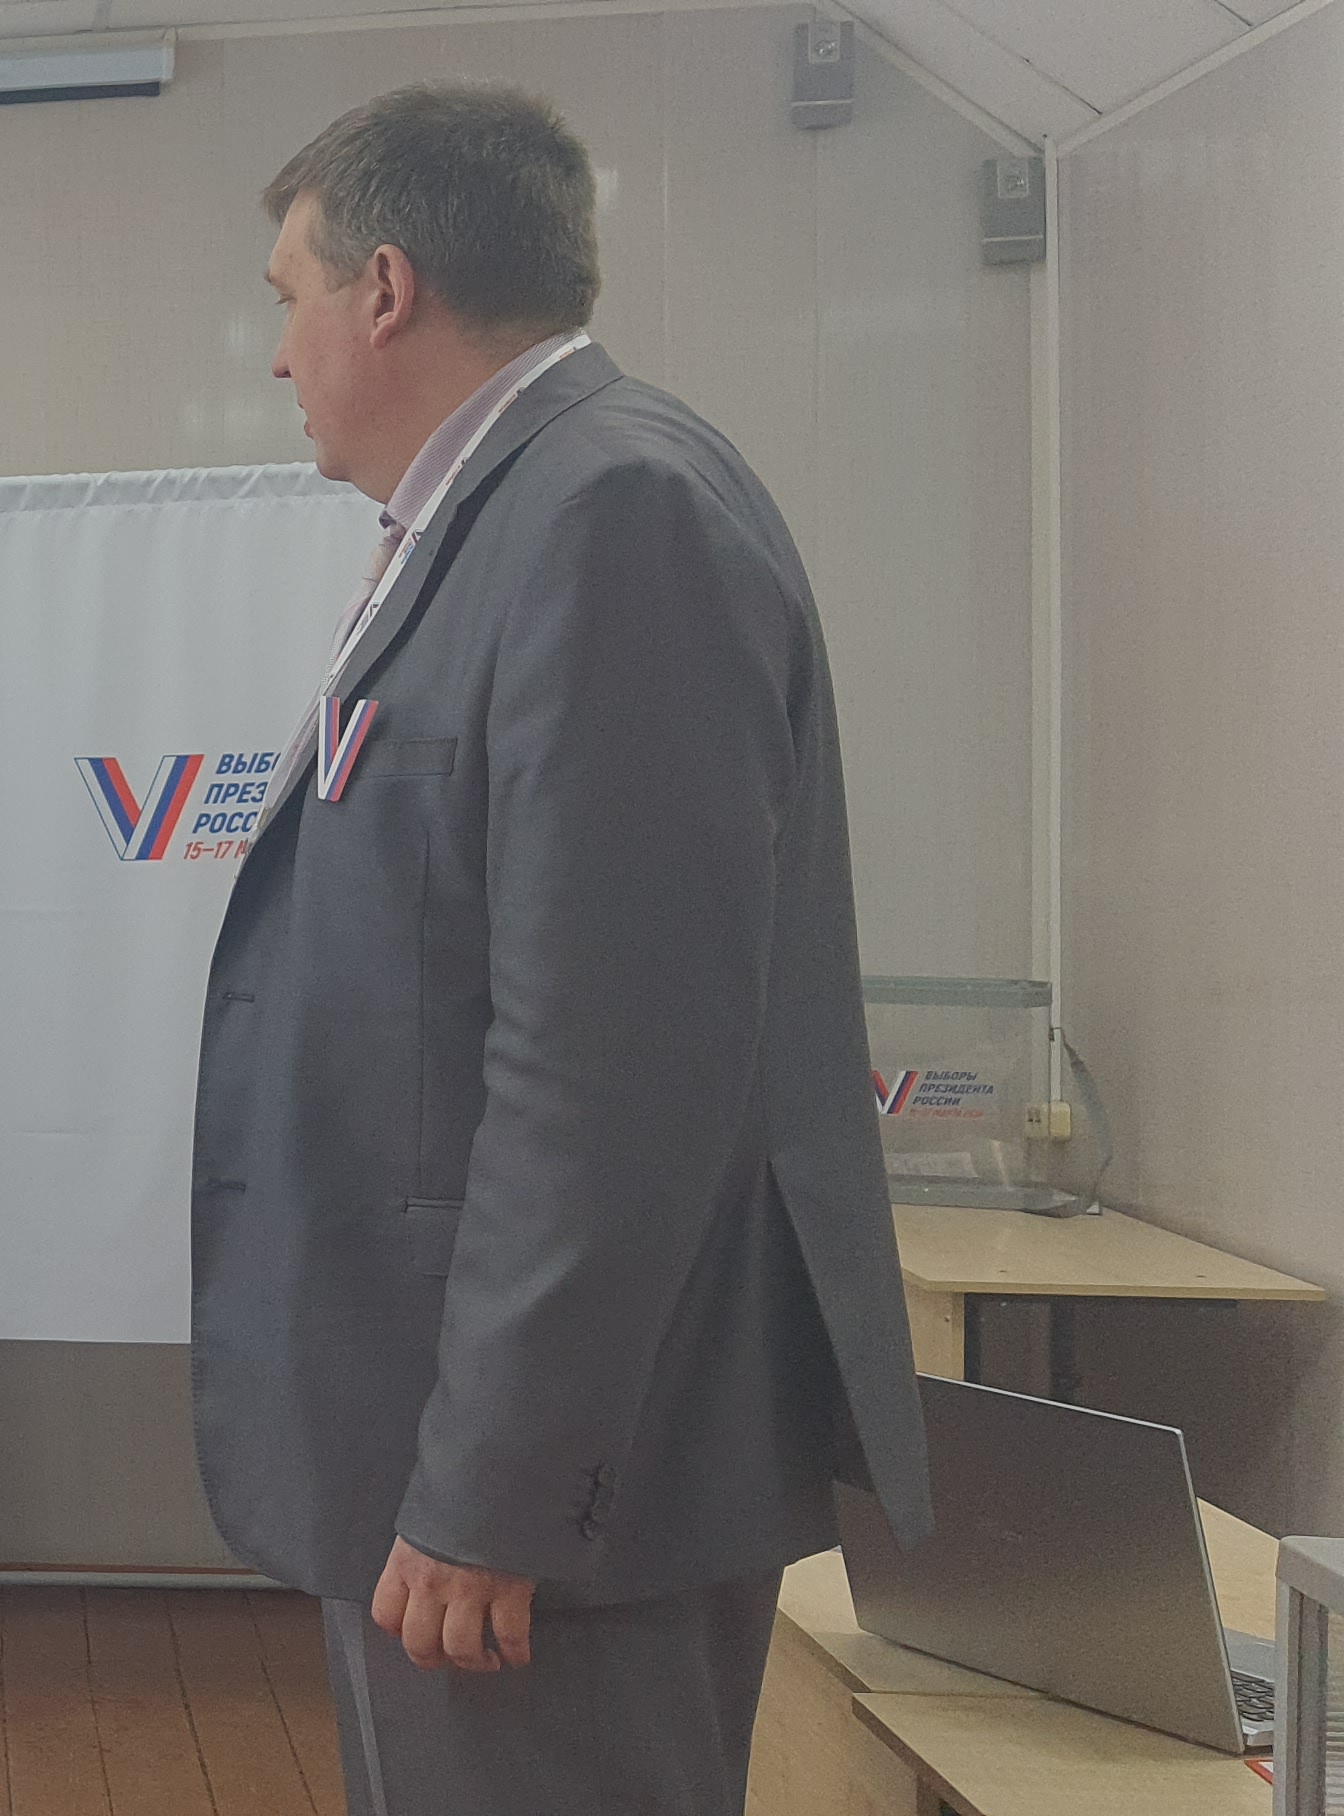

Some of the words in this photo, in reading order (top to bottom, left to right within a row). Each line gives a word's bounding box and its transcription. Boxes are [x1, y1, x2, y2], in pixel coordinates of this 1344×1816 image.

[925, 1070, 978, 1081] ВЫБОРЫ
[918, 1083, 994, 1095] ПРЕЗИДЕНТА
[912, 1095, 961, 1106] РОССИИ
